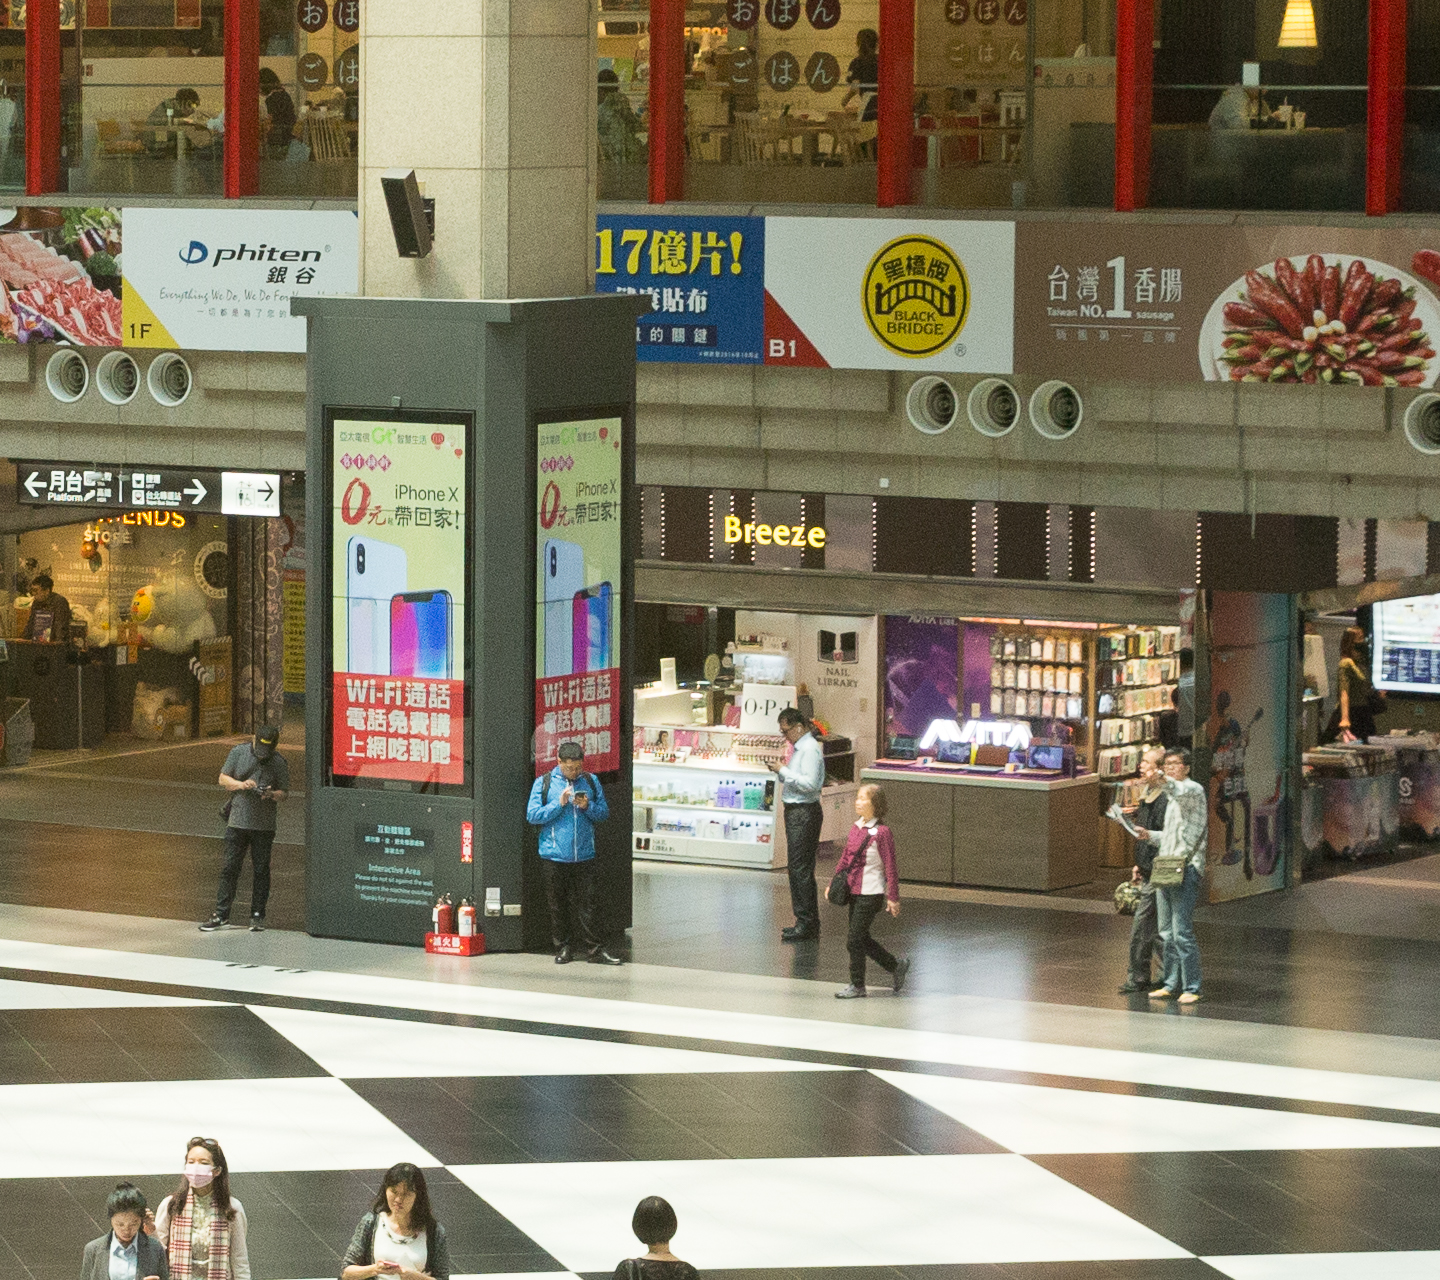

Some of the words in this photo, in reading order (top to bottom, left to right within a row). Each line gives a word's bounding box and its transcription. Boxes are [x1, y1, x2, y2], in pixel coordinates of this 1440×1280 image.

[949, 0, 1026, 21] おぼん
[732, 58, 834, 84] ごはん
[212, 243, 322, 268] phiten
[595, 228, 743, 276] 17億片!
[265, 266, 316, 285] 銀谷
[882, 254, 950, 283] 黑橋牌
[159, 287, 209, 304] Everything
[211, 288, 223, 301] We
[244, 289, 257, 301] We
[259, 289, 272, 301] Do
[1047, 264, 1099, 303] 台灣
[1105, 255, 1132, 319] 1
[1134, 266, 1182, 304] 香腸
[893, 310, 937, 322] BLACK
[1047, 306, 1078, 317] Taiwan
[1079, 304, 1105, 319] NO.
[1136, 310, 1175, 321] sausage
[129, 323, 152, 339] 1F
[886, 322, 944, 336] BRIDGE
[769, 336, 798, 359] B1
[49, 470, 83, 493] 月台
[575, 480, 608, 498] iPhone
[608, 477, 618, 495] X
[48, 492, 83, 503] Platform
[395, 484, 446, 502] iPhone
[448, 486, 459, 502] X
[394, 505, 460, 530] 帶回家!
[575, 500, 618, 523] 帶回家!
[723, 515, 827, 549] Breeze
[825, 666, 850, 678] NAIL
[817, 677, 859, 689] LIBRARY
